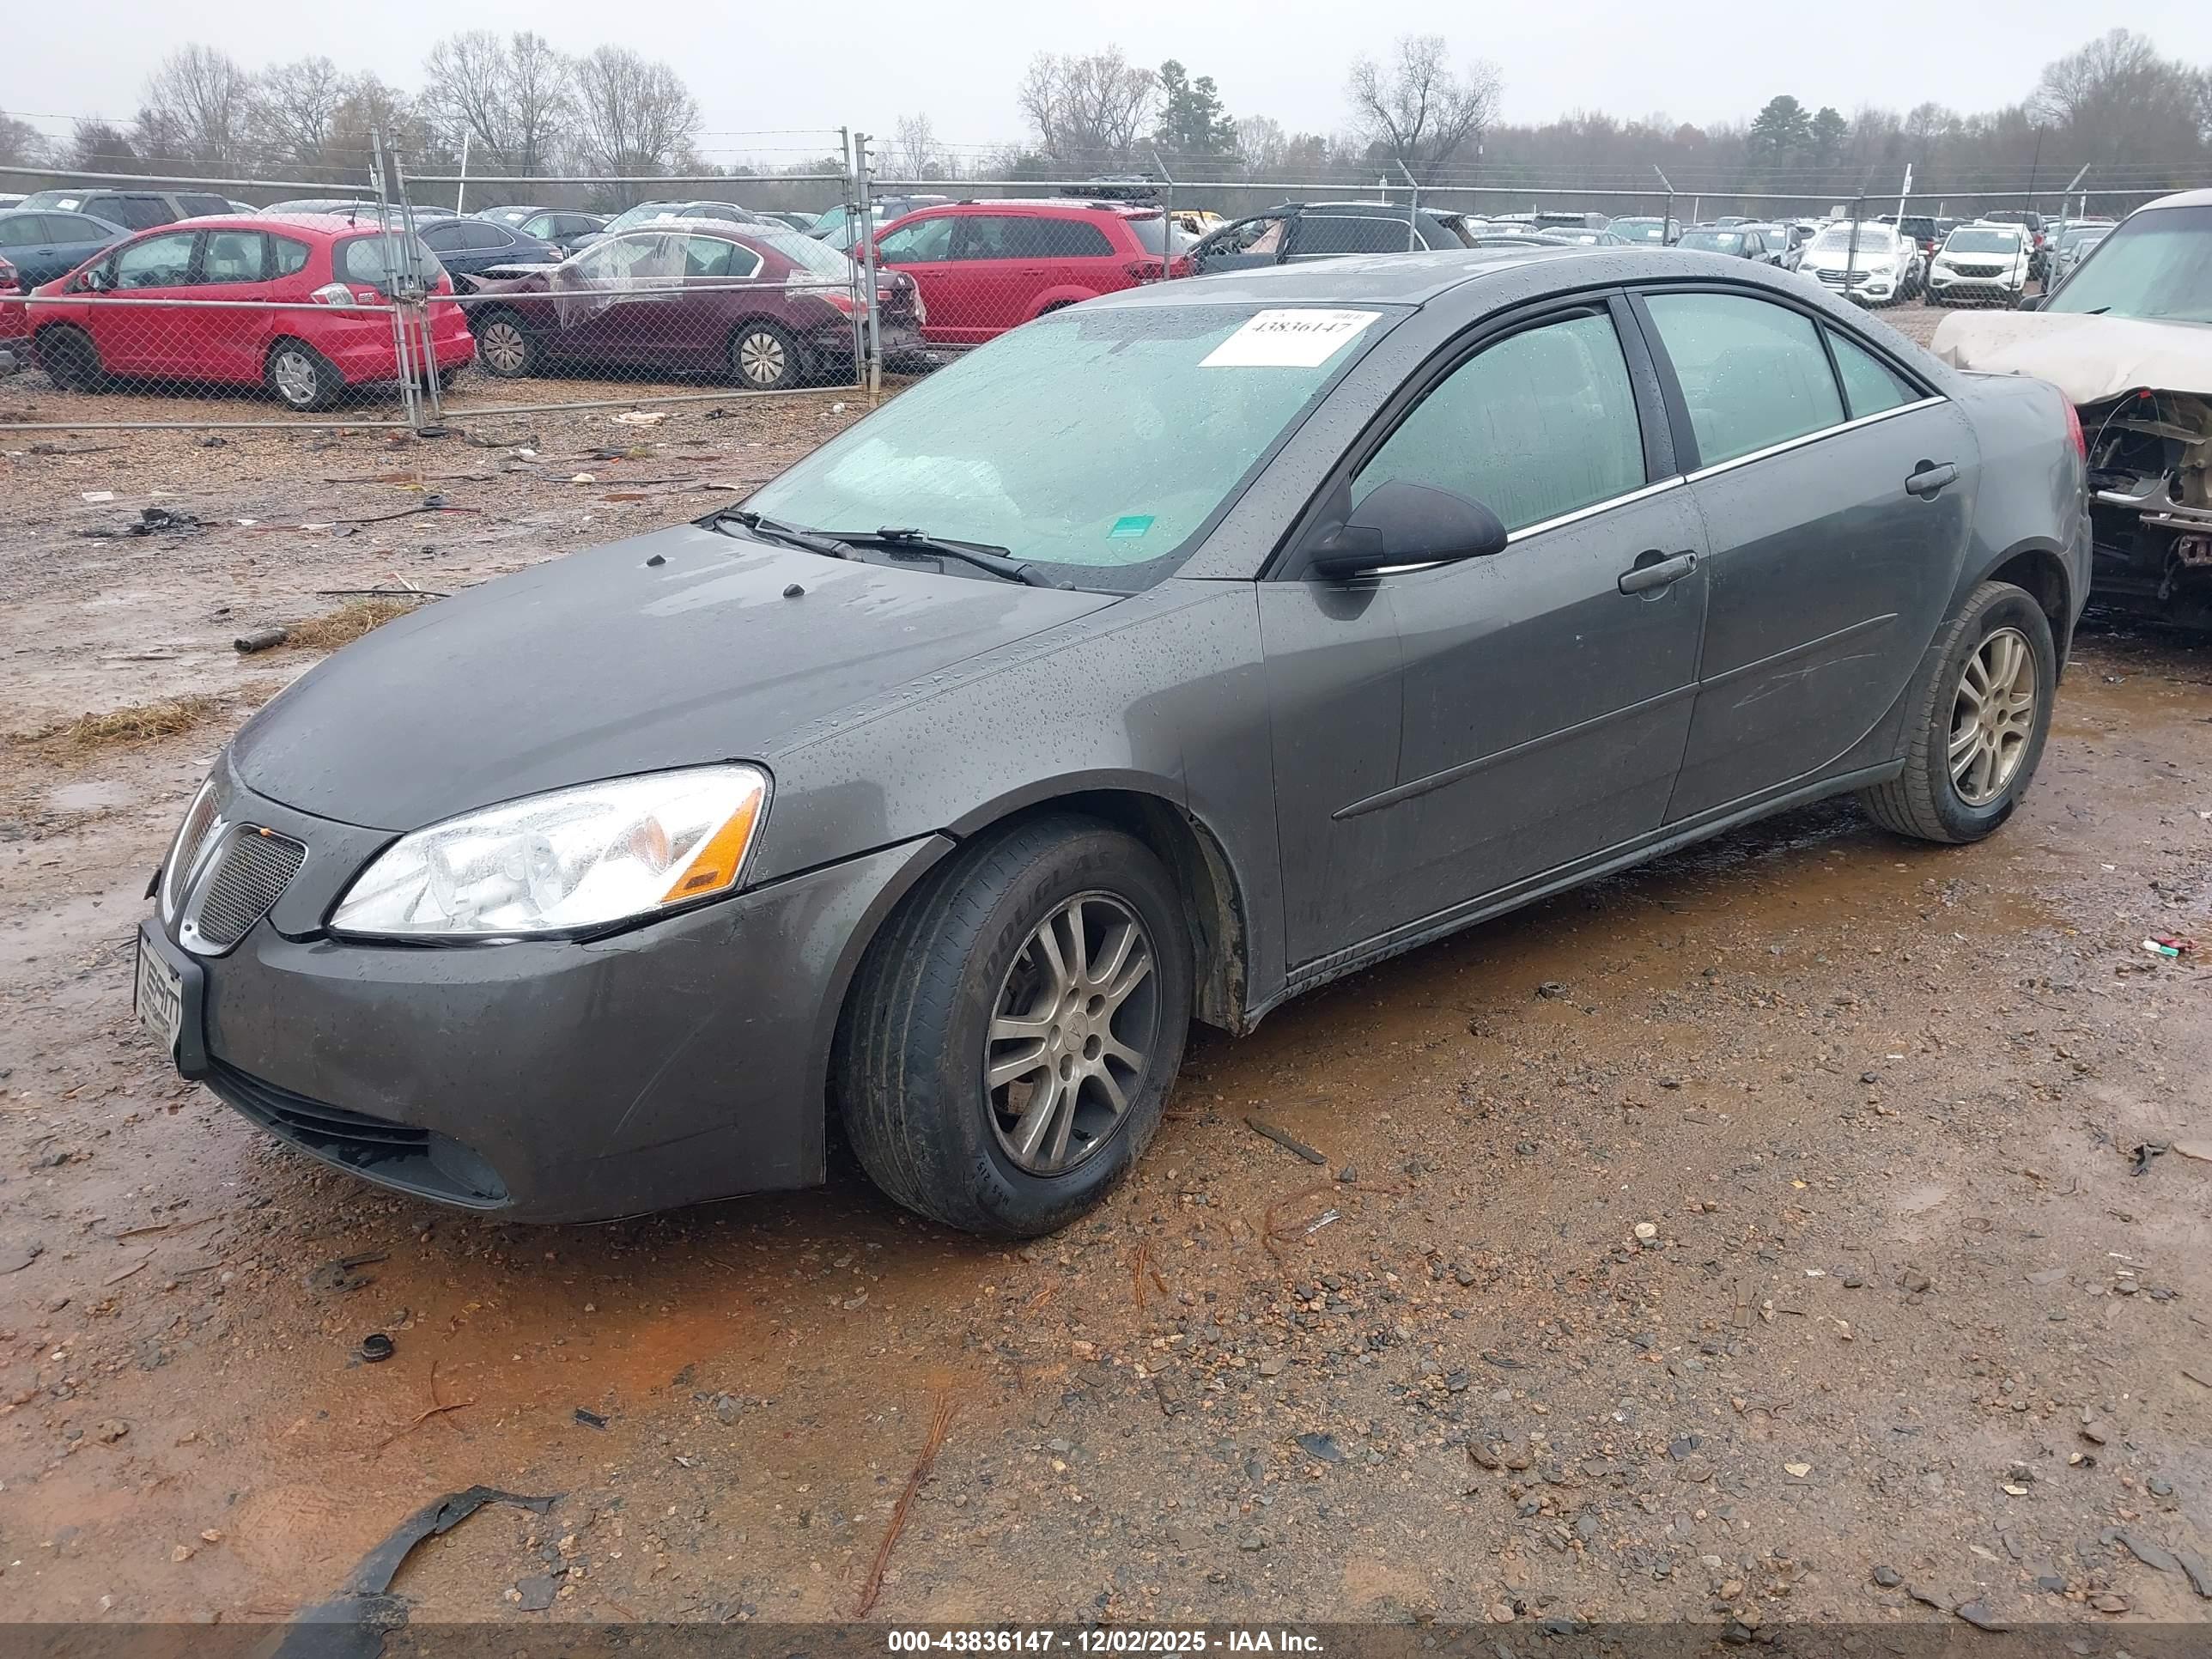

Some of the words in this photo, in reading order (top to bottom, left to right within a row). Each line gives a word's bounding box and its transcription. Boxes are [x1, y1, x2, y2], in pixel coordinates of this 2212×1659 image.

[1252, 321, 1353, 333] 43836147
[983, 850, 1110, 978] DOUGLAS
[141, 948, 179, 1025] TEAM
